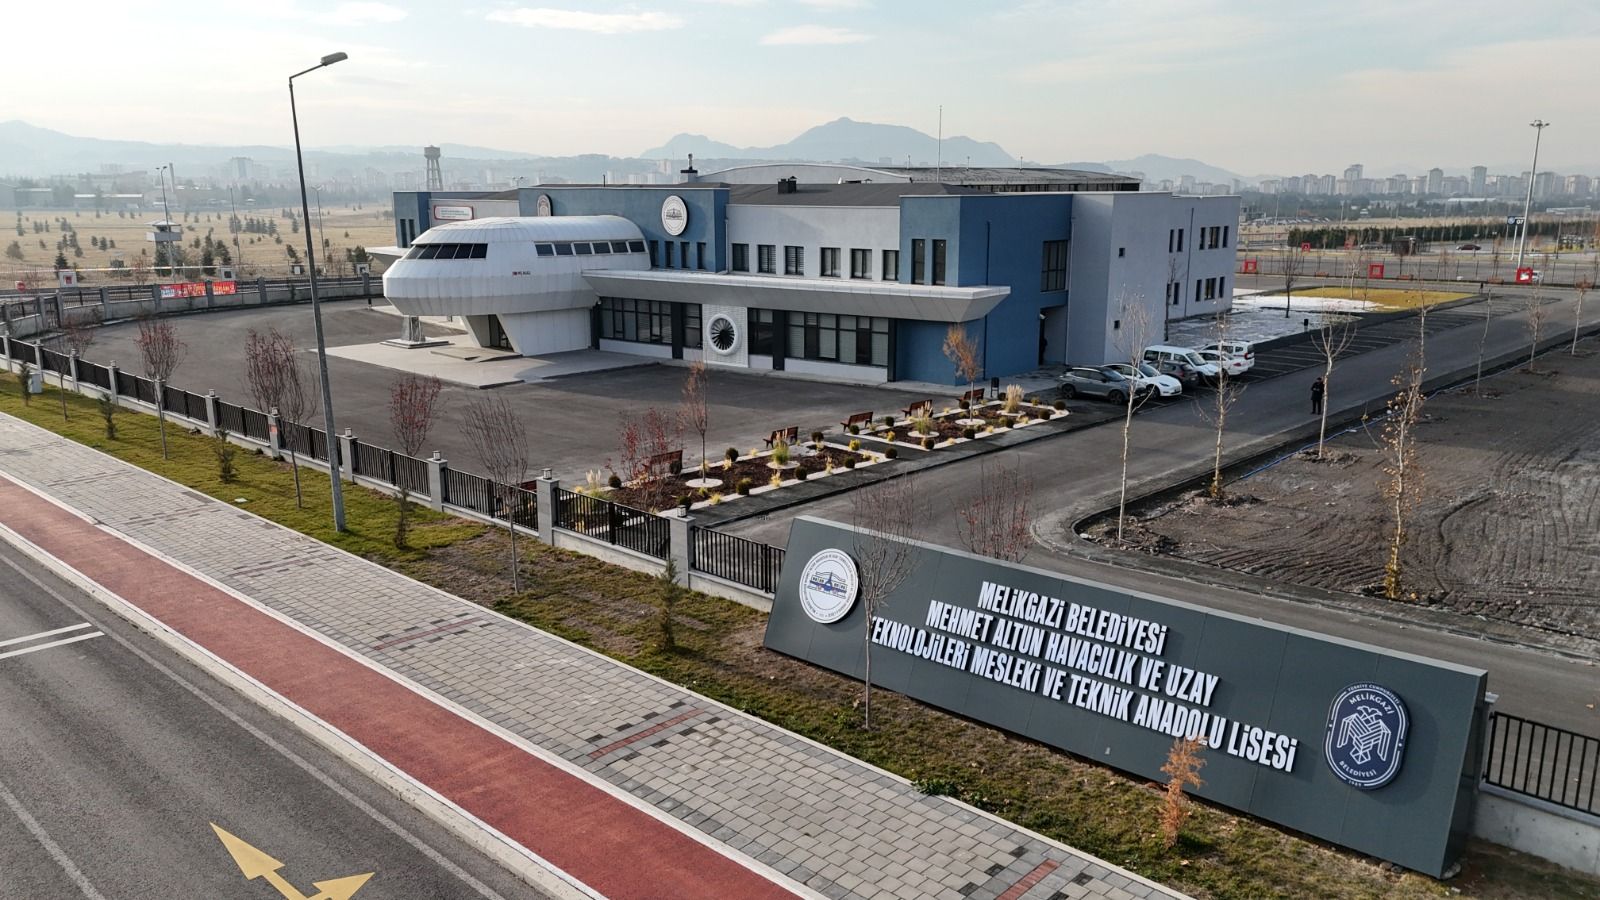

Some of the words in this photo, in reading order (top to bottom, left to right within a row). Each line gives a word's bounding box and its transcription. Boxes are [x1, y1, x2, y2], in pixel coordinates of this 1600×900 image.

[925, 600, 994, 642] MEHMET
[992, 618, 1045, 658] ALTUN
[1044, 632, 1138, 685] HAVACILIK
[1139, 656, 1165, 692] VE
[1165, 664, 1219, 707] UZAY
[977, 581, 1065, 629] MELİKGAZİ
[1066, 603, 1168, 655] BELEDİYESİ
[970, 646, 1042, 693] MESLEKİ
[1042, 667, 1068, 700] VE
[1067, 674, 1134, 721] TEKNİK
[1133, 695, 1227, 749] ANADOLU
[1227, 721, 1298, 772] LİSESİ
[1349, 692, 1395, 714] MELİKGAZİ
